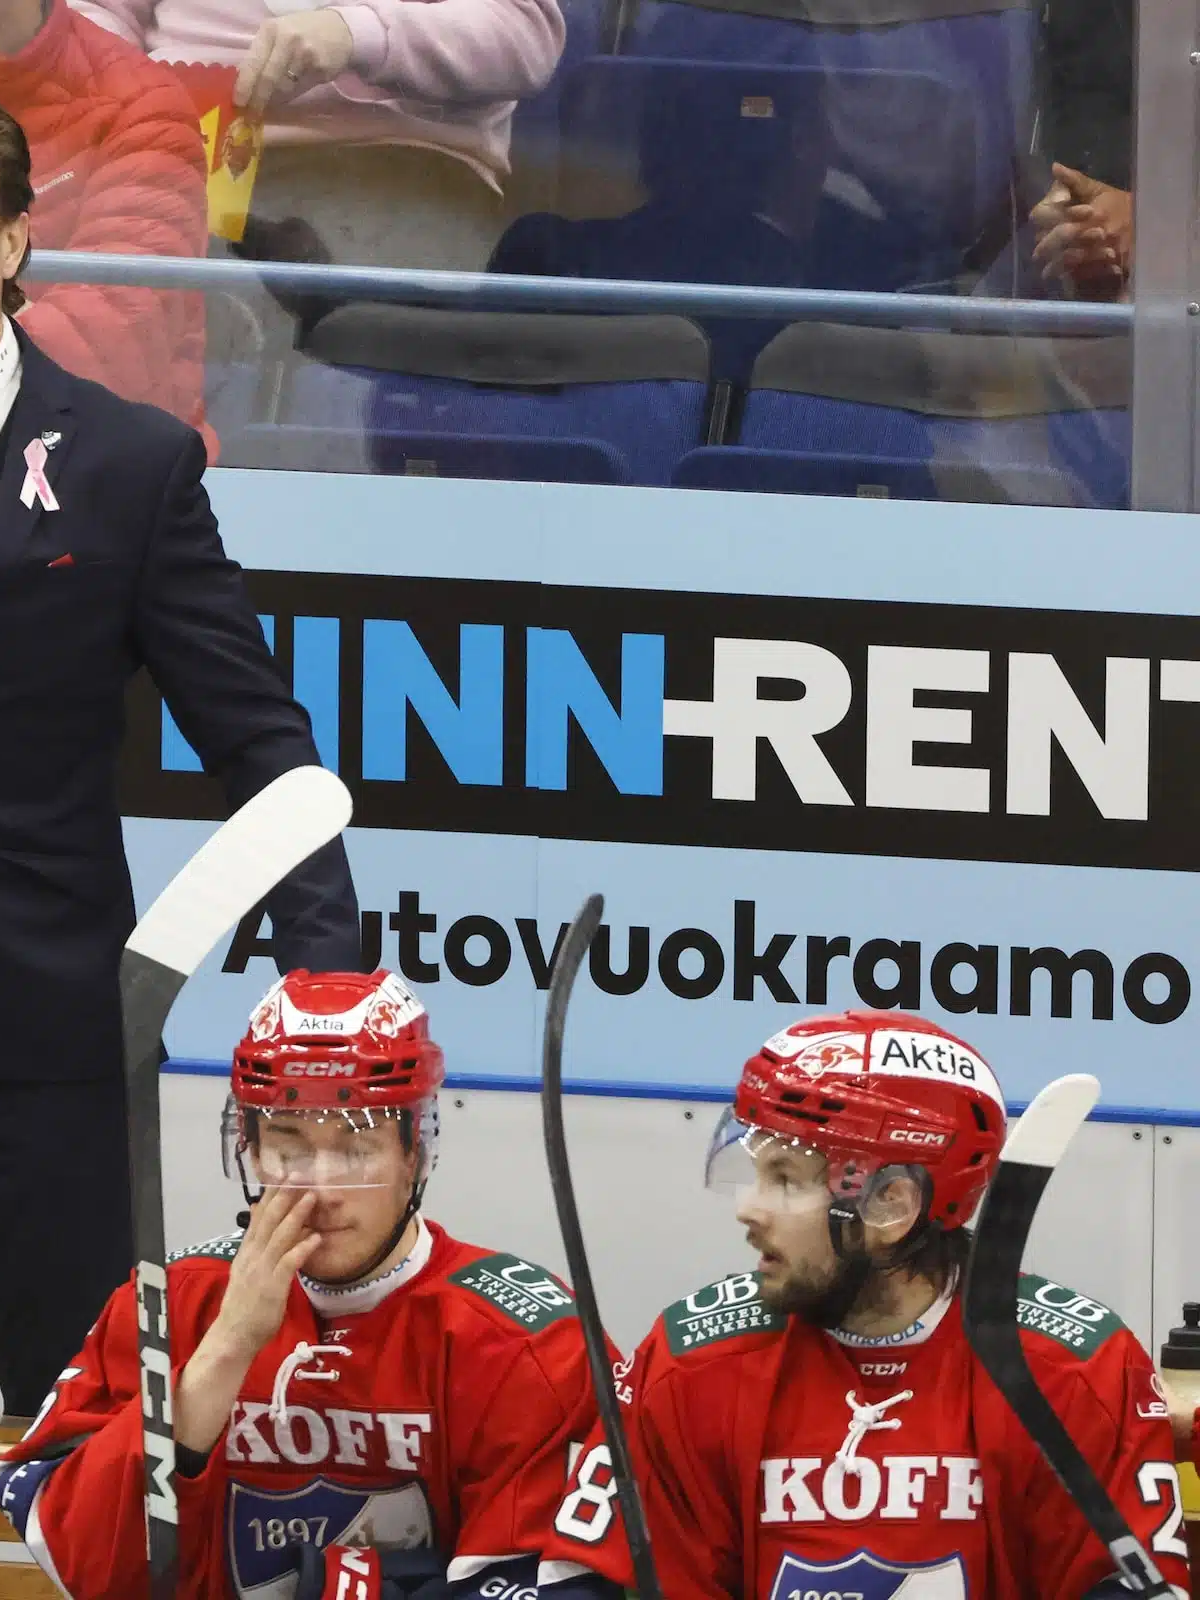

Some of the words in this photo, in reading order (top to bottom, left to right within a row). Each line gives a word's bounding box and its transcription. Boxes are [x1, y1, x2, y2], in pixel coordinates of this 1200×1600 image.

[161, 614, 1200, 822] INN-REN
[298, 1017, 345, 1031] Aktia
[283, 1061, 357, 1077] CCM
[880, 1037, 977, 1081] Aktia
[889, 1129, 947, 1145] CCM
[460, 1276, 538, 1324] BANKERS
[477, 1274, 541, 1314] UNITED
[501, 1260, 573, 1307] UB
[683, 1272, 760, 1315] UB
[1034, 1280, 1110, 1323] UB
[682, 1314, 772, 1347] BANKERS
[687, 1306, 763, 1333] UNITED
[1016, 1302, 1085, 1336] UNITED
[860, 1361, 908, 1376] CCM
[136, 1260, 179, 1526] CCM
[225, 1400, 433, 1473] KOFF
[247, 1515, 329, 1553] 1897
